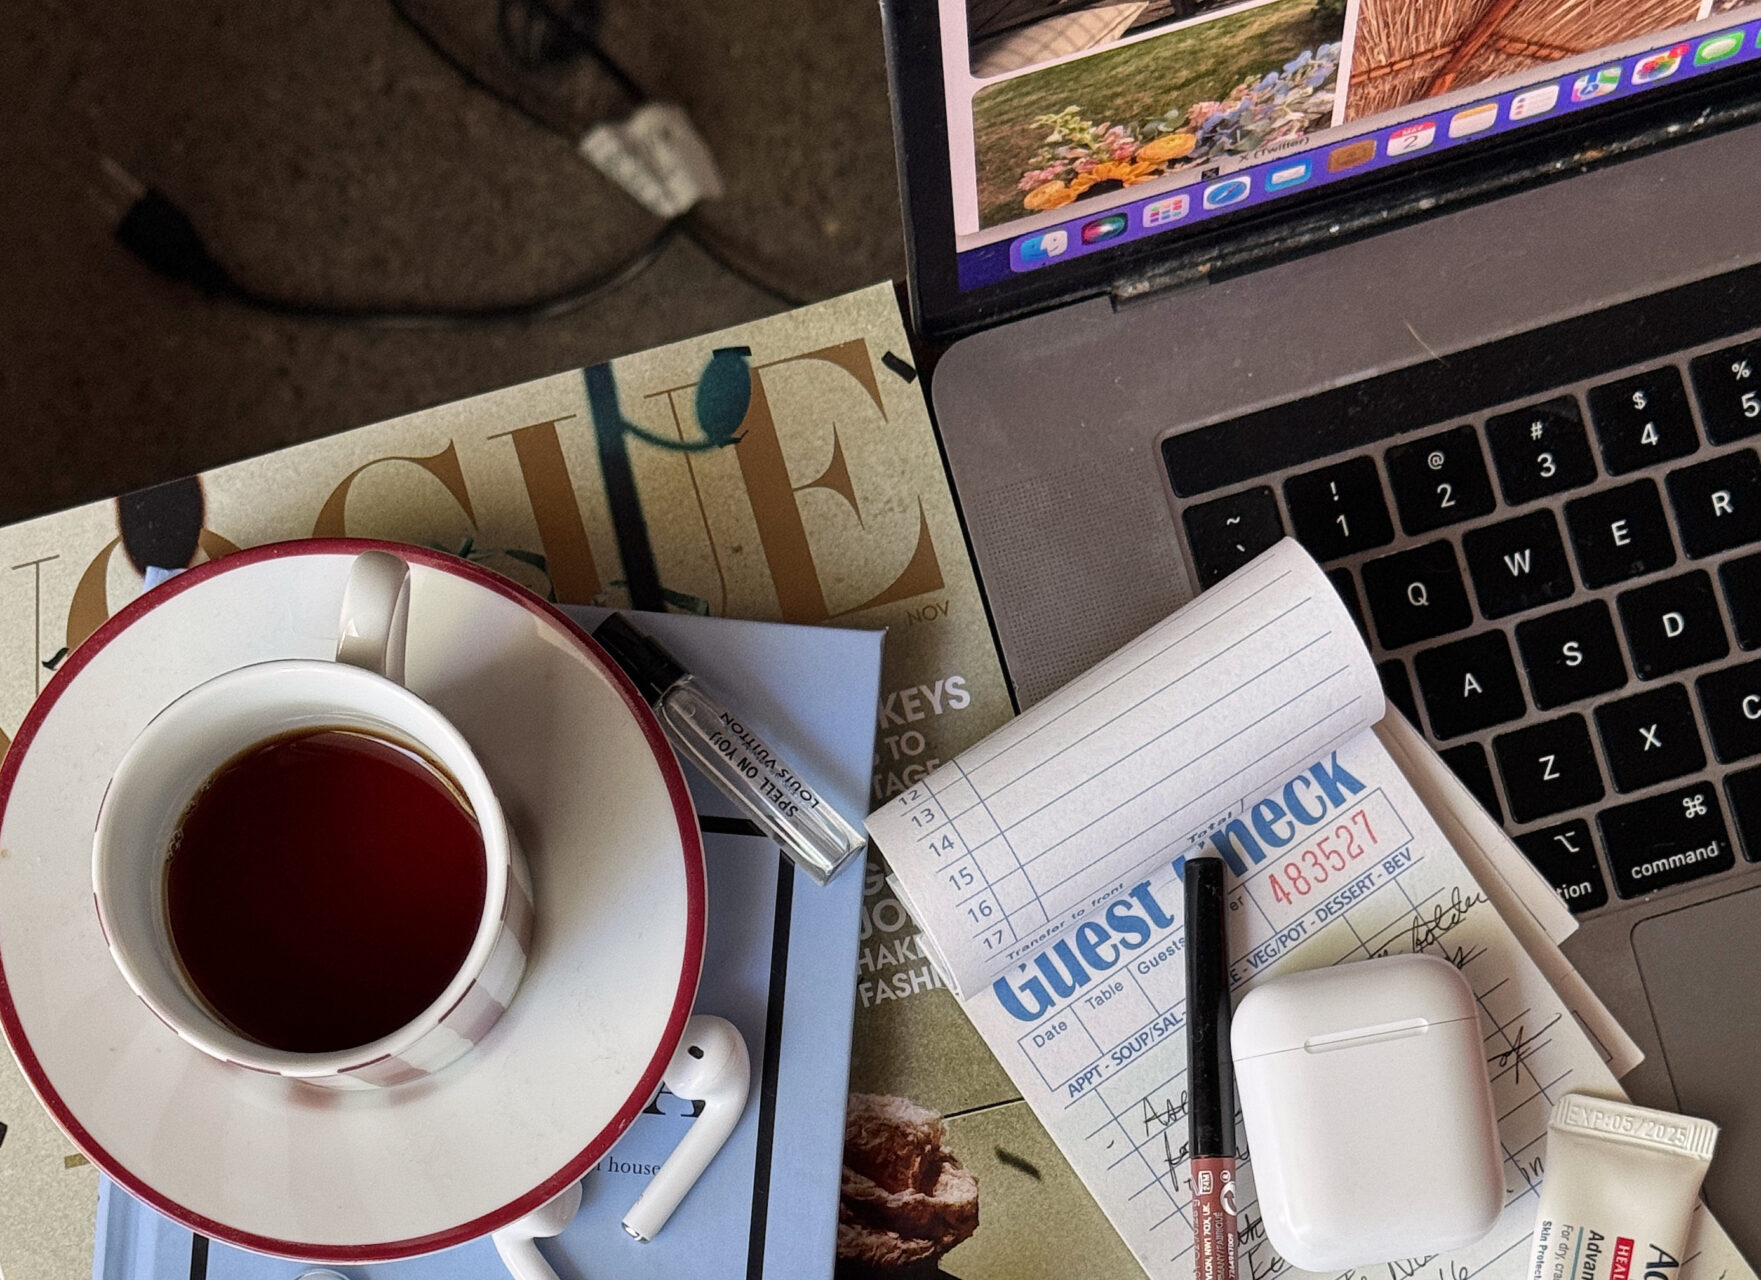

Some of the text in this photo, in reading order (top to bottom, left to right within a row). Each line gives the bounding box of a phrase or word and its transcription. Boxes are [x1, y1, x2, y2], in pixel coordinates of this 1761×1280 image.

[1253, 137, 1310, 160] (Twitter)
[1403, 136, 1418, 149] 2
[1742, 394, 1761, 417] 5
[1640, 423, 1659, 447] 4
[1537, 453, 1556, 478] 3
[1436, 485, 1456, 507] 2
[1711, 490, 1734, 517] R
[1336, 515, 1349, 537] 1
[1610, 520, 1631, 547] E
[1504, 550, 1532, 577] W
[1407, 582, 1429, 607] Q
[907, 600, 950, 626] NOV
[1663, 612, 1685, 639] D
[1563, 641, 1583, 667] S
[1462, 672, 1483, 698] A
[879, 676, 971, 729] KEYS
[1742, 694, 1761, 722] C
[720, 712, 779, 771] VUITTON
[884, 731, 925, 760] TO
[1639, 724, 1662, 751] X
[708, 731, 798, 817] SPELL ON YOU
[1539, 755, 1561, 781] Z
[778, 770, 820, 809] LOUIS
[899, 789, 921, 806] 12
[911, 807, 935, 828] 13
[1187, 811, 1233, 844] Total
[929, 835, 955, 857] 14
[1268, 809, 1378, 906] 483527
[1631, 840, 1719, 880] command
[949, 867, 974, 891] 15
[993, 750, 1367, 1022] Guest heck
[967, 900, 993, 924] 16
[1072, 909, 1086, 920] to
[1091, 883, 1125, 907] front
[982, 930, 1004, 950] 17
[1137, 935, 1186, 975] Guests
[1067, 1068, 1103, 1099] APPT
[1247, 923, 1308, 968] VEG/POT
[1315, 874, 1377, 924] DESSERT
[1385, 847, 1413, 879] BEV
[1085, 980, 1125, 1012] Table
[1032, 1020, 1068, 1049] Date
[608, 1156, 661, 1176] house
[1540, 1220, 1552, 1241] Skin
[1562, 1224, 1573, 1240] For
[1558, 1242, 1570, 1261] dry,
